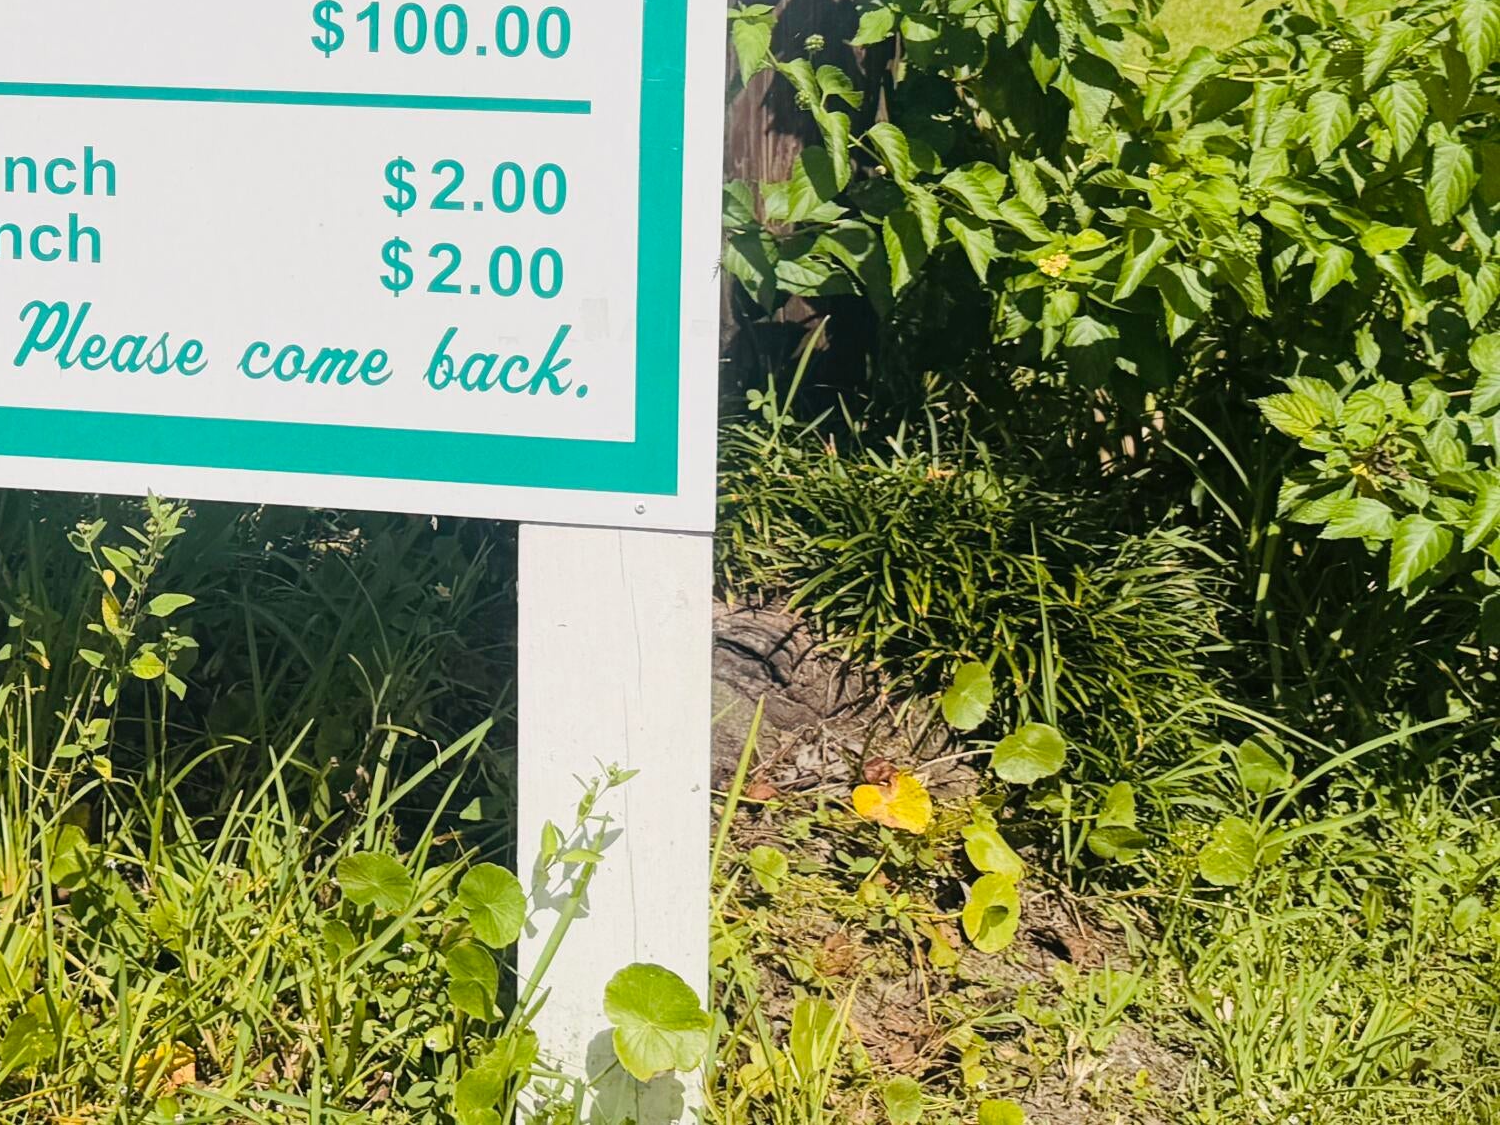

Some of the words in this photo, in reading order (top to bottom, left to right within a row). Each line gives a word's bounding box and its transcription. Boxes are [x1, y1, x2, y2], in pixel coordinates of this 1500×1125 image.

[14, 300, 205, 376] Please
[239, 342, 389, 386] come
[426, 325, 588, 397] back.
